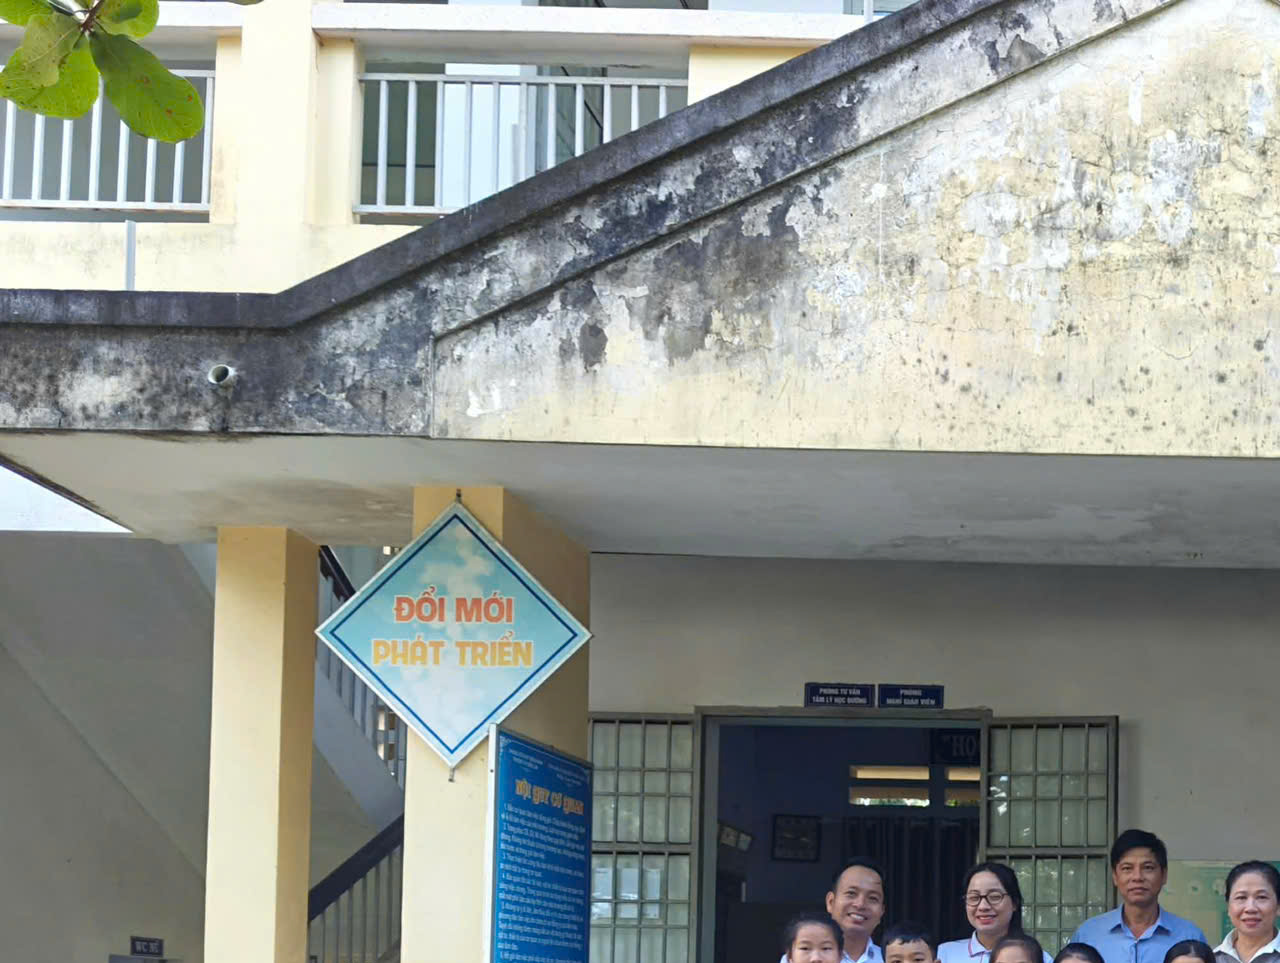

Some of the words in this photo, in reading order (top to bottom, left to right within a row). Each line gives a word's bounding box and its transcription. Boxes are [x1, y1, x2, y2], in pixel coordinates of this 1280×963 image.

[394, 586, 445, 622] ĐỔI
[455, 591, 514, 622] MỚI
[373, 635, 444, 666] PHÁT
[455, 631, 533, 667] TRIỂN
